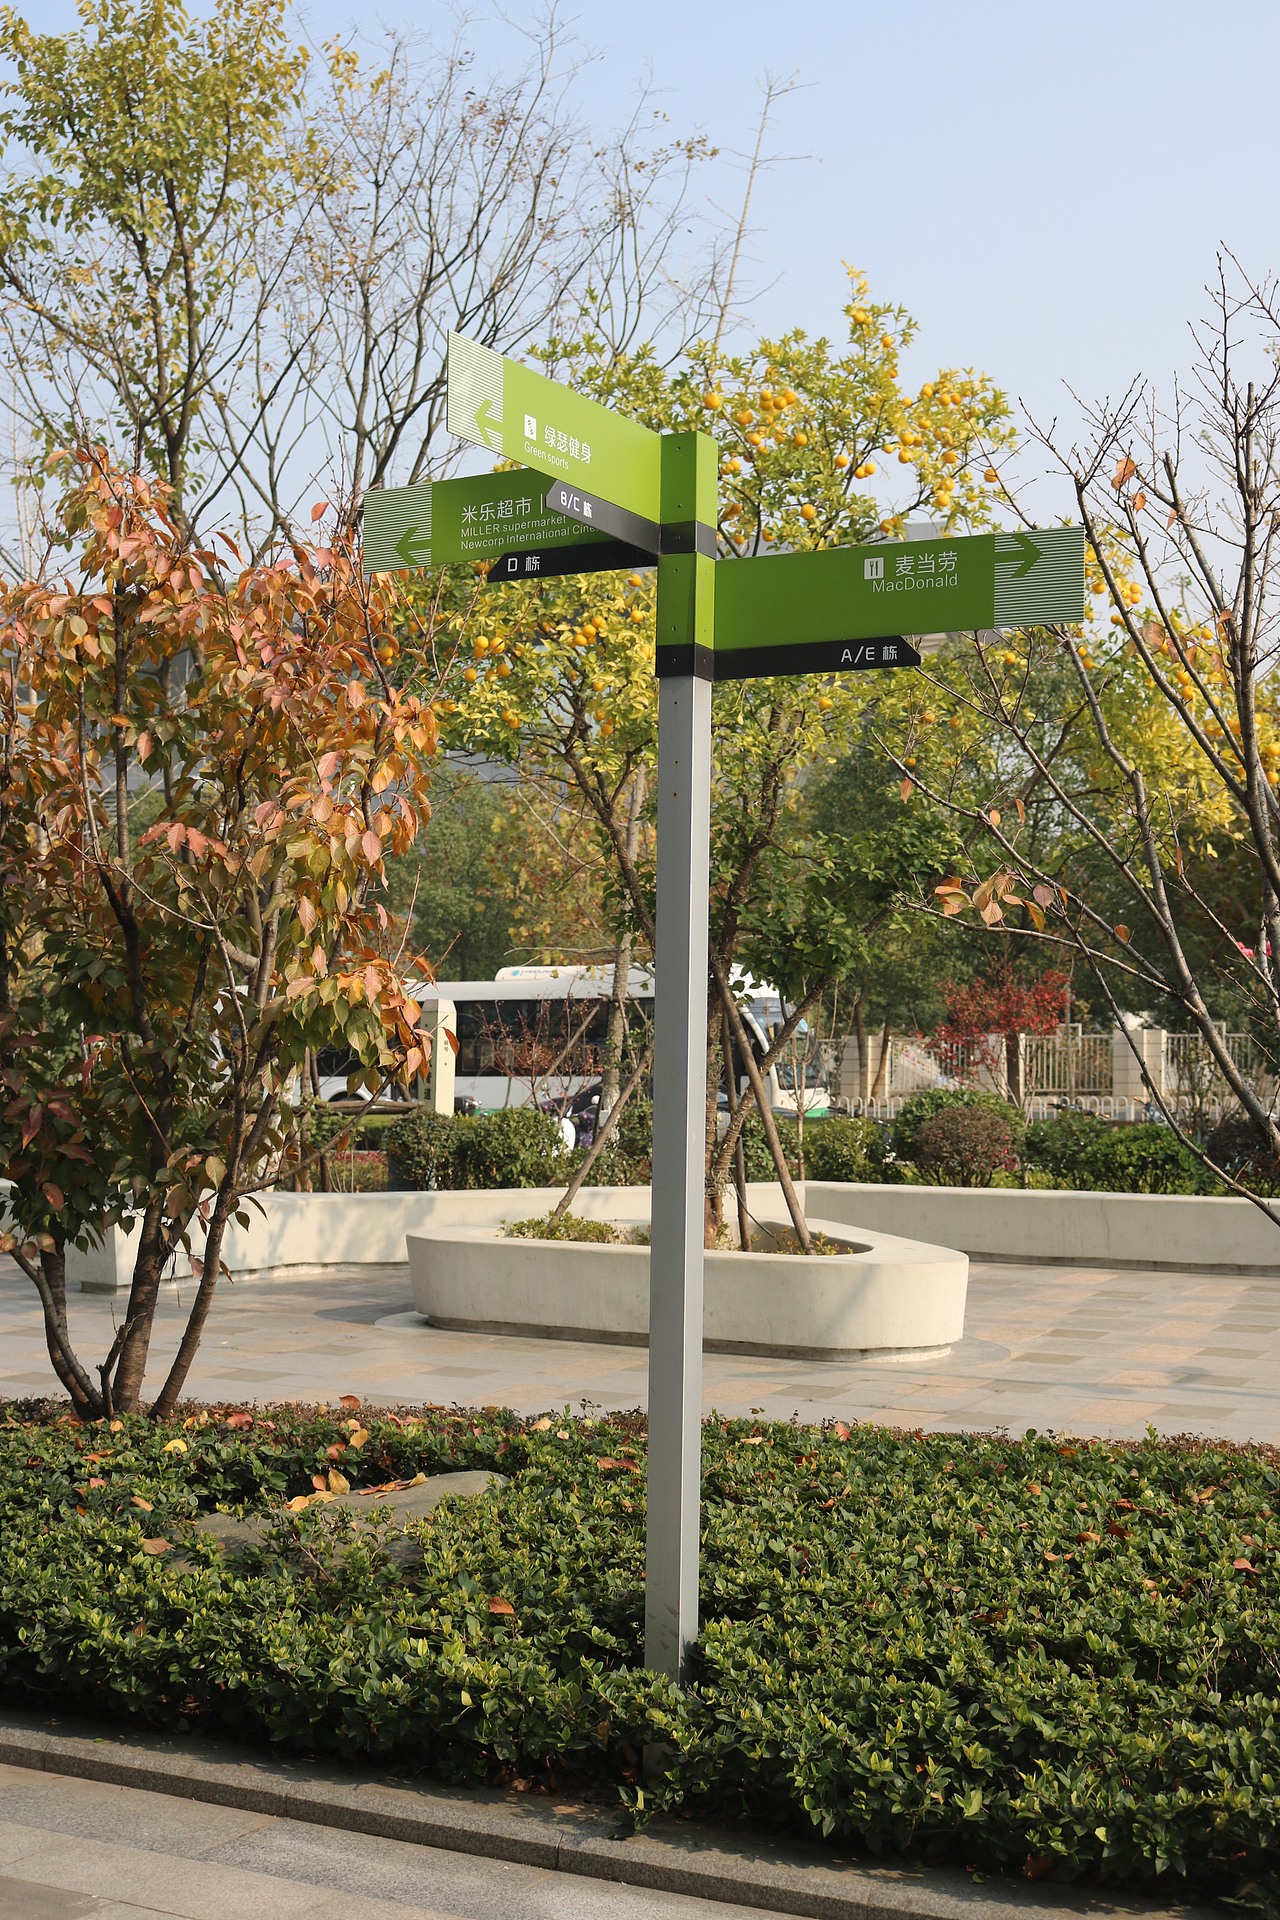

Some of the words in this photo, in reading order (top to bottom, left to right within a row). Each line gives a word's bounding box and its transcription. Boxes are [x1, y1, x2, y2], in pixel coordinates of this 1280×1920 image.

[524, 441, 546, 460] Green
[547, 451, 569, 470] sports
[544, 424, 592, 464] 绿瑟健身
[461, 497, 532, 524] 米乐超市
[560, 491, 580, 513] B/C
[583, 500, 593, 519] 栋
[460, 523, 500, 538] MILLER
[502, 515, 566, 534] supermarket
[460, 537, 504, 550] Newcorp
[506, 527, 570, 543] International
[572, 524, 599, 535] Cine
[507, 557, 518, 572] D
[525, 556, 540, 572] 栋
[895, 551, 958, 577] 麦当劳
[872, 573, 958, 593] MacDonald
[841, 645, 875, 663] A/E
[882, 645, 898, 661] 栋
